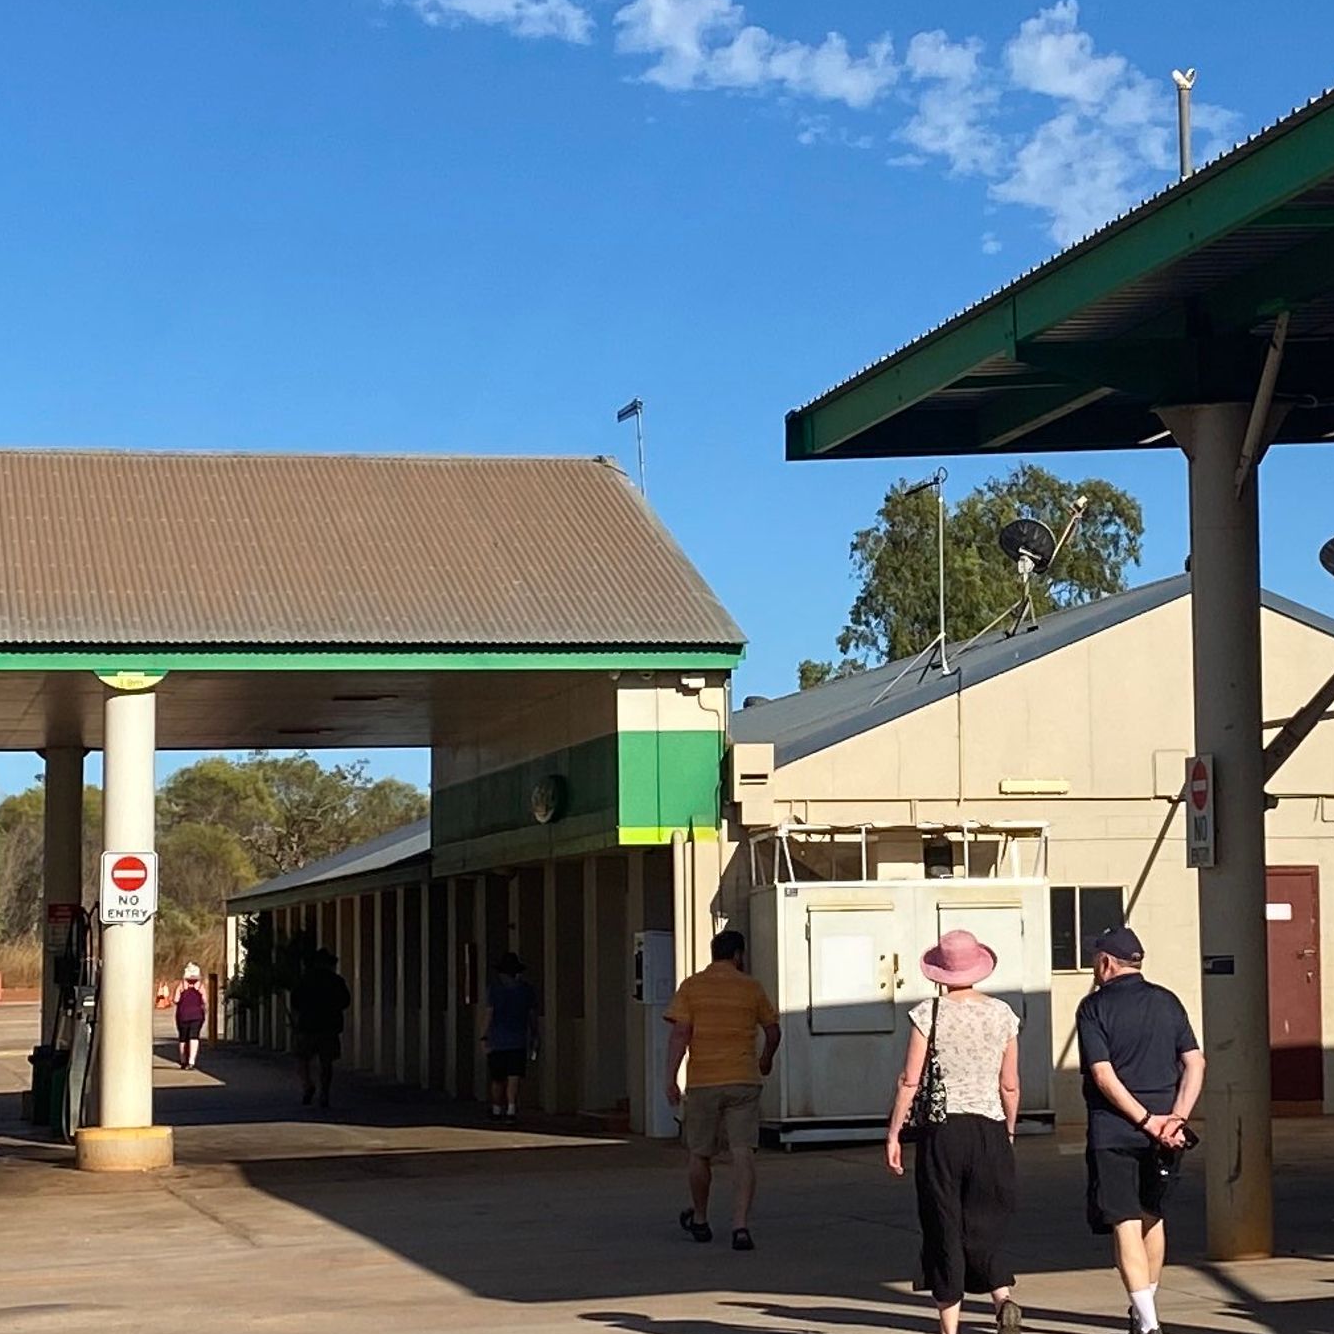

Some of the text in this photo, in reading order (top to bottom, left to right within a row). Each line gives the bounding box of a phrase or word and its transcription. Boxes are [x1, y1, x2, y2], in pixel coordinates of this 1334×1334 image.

[1194, 815, 1208, 842] NO
[118, 895, 140, 906] NO
[107, 908, 148, 919] ENTRY
